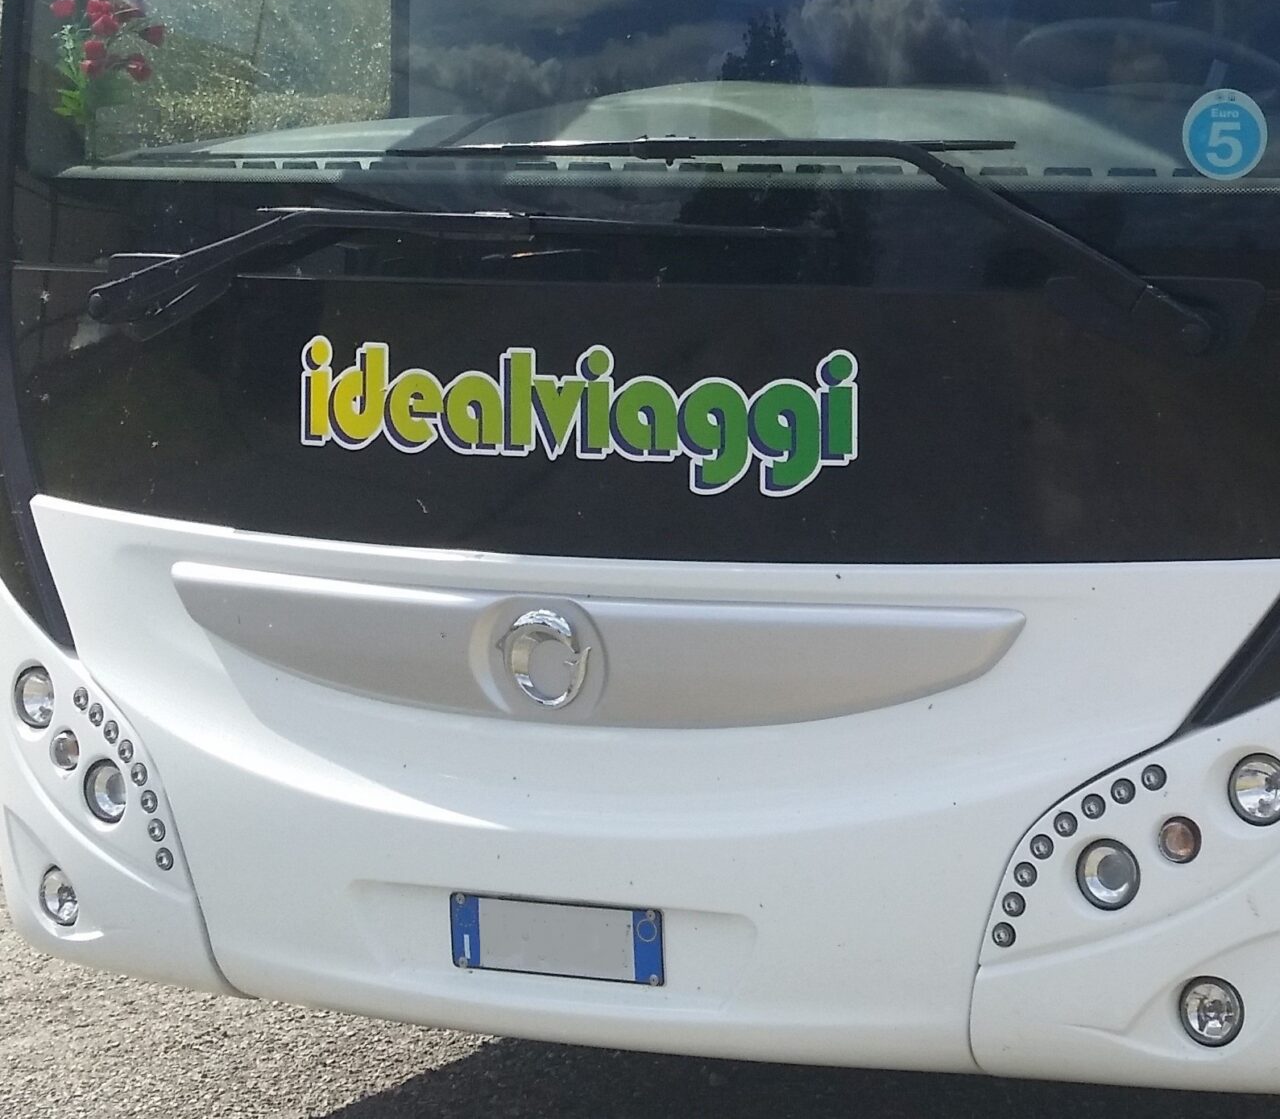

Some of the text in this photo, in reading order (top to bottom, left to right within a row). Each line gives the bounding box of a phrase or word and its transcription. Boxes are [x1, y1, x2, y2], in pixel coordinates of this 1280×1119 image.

[1211, 108, 1240, 118] Euro
[1206, 121, 1243, 168] 5
[302, 335, 859, 497] idealviaggi
